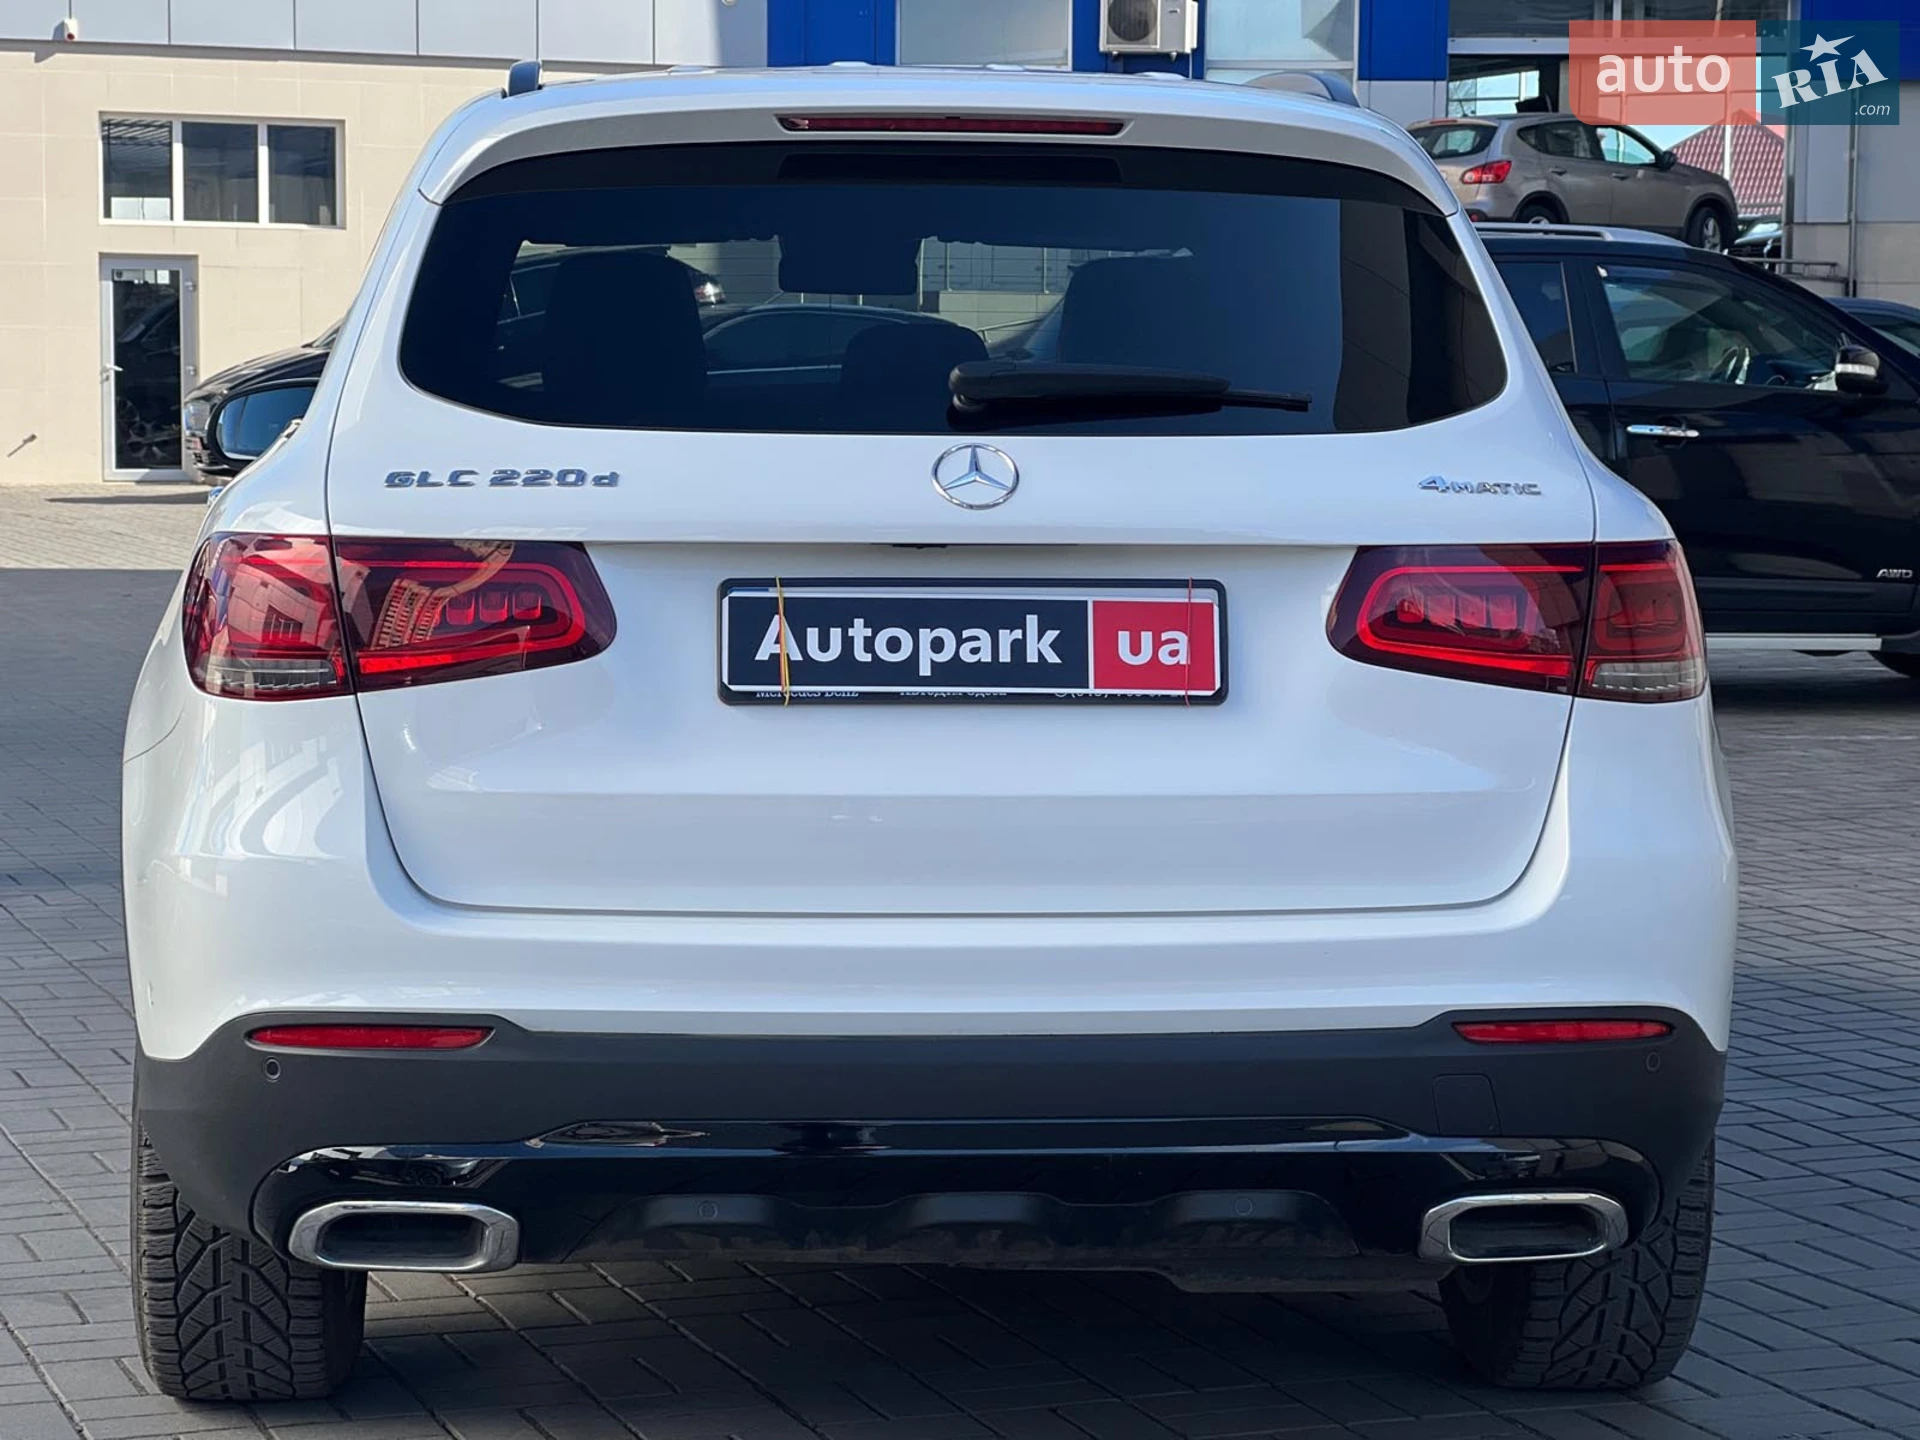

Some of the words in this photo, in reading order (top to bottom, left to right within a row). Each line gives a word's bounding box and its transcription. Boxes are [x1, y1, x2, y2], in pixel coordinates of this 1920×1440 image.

[384, 469, 480, 489] GLC
[1418, 475, 1542, 496] 4MATIC
[1876, 568, 1914, 579] AWD
[754, 613, 1063, 677] Autopark
[1116, 629, 1192, 665] ua
